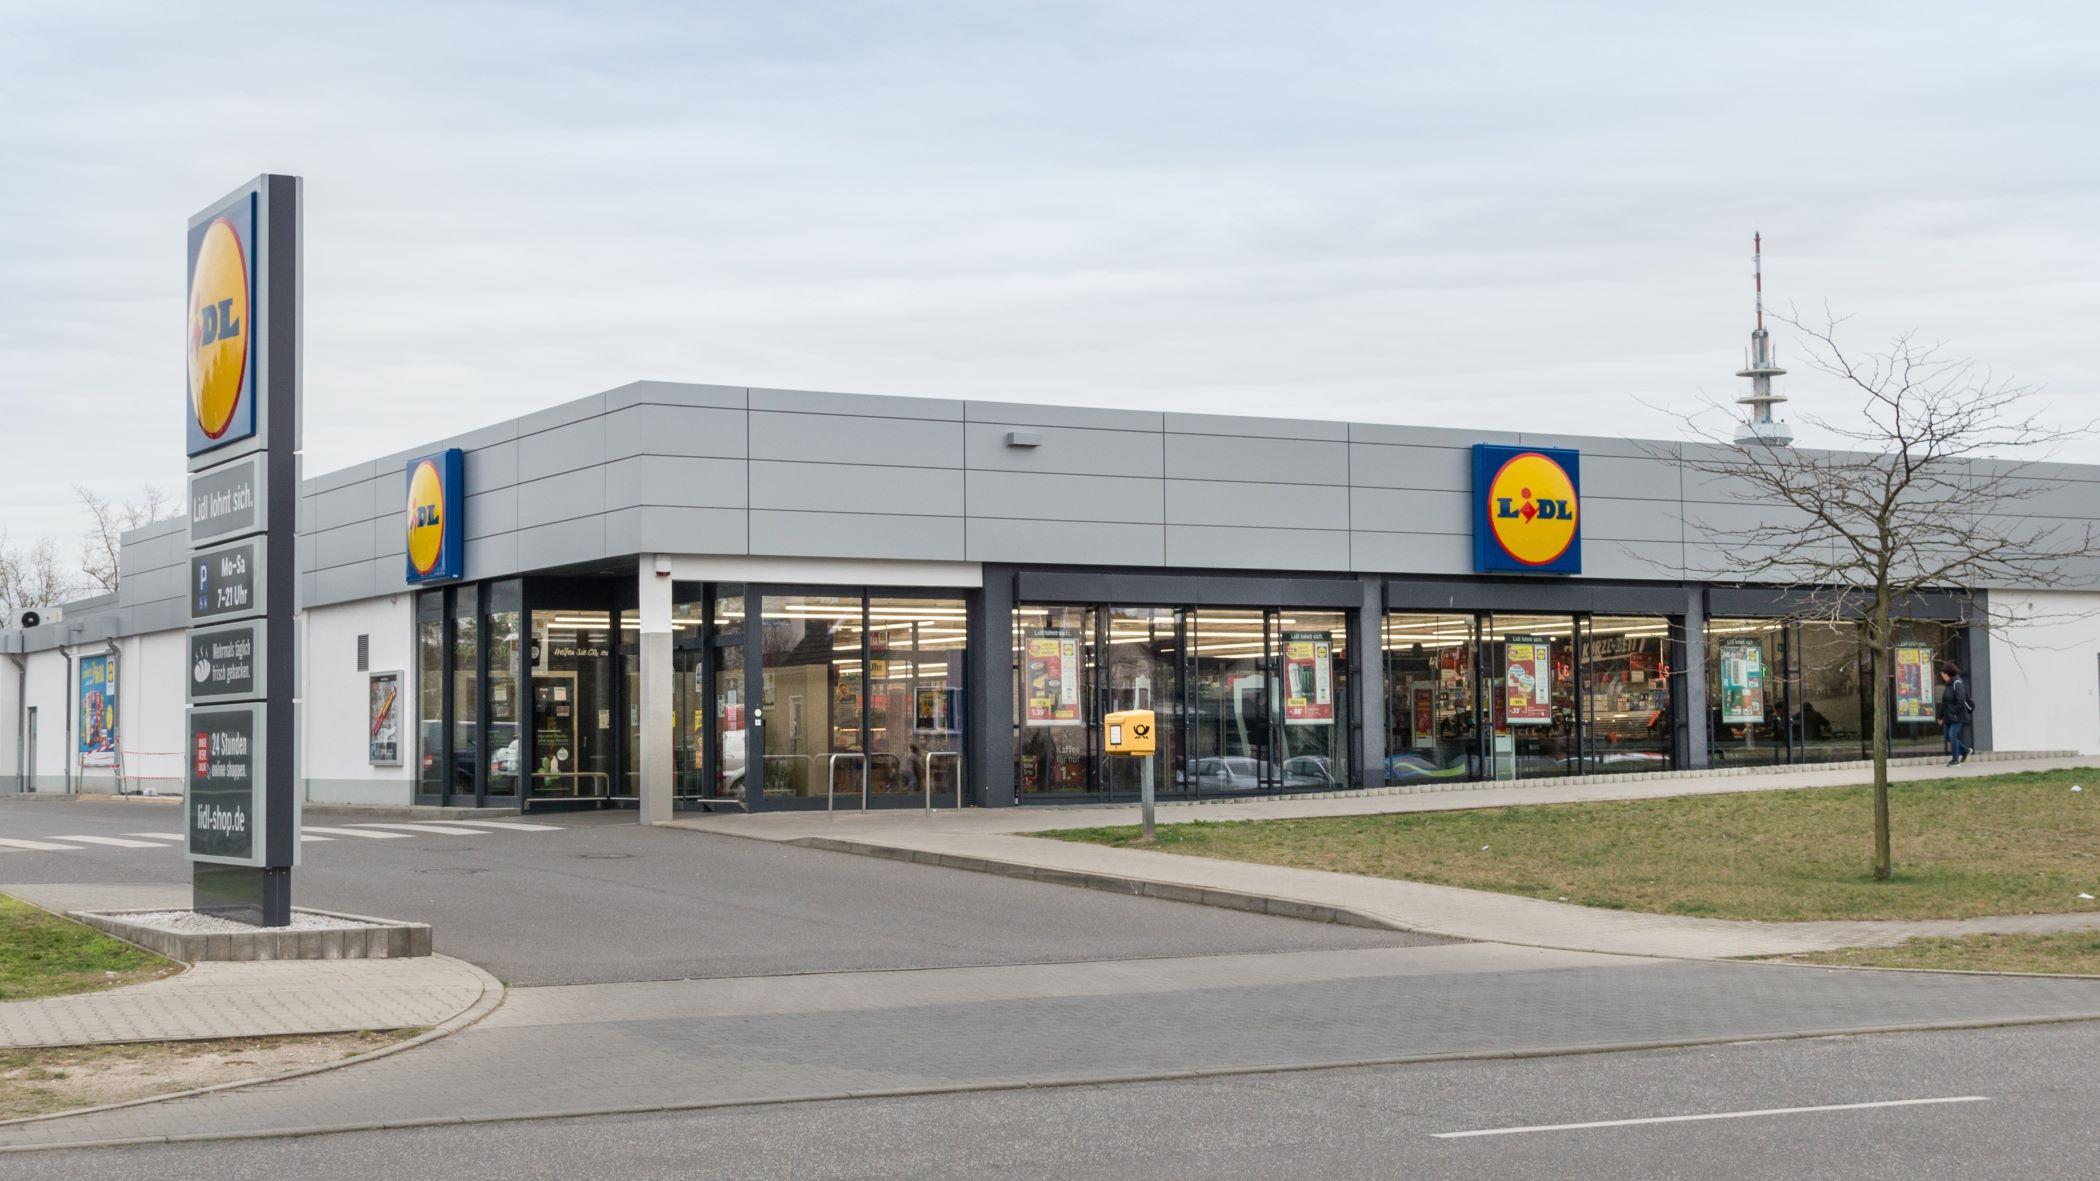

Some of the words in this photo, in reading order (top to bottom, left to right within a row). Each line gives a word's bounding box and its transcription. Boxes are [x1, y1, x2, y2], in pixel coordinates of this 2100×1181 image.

[193, 494, 208, 522] Lidl
[210, 488, 231, 518] lohnt
[233, 481, 253, 512] sich.
[221, 553, 246, 577] Mo-Sa
[200, 565, 208, 590] P
[234, 583, 248, 606] Uhr
[212, 640, 235, 660] Mehrmals
[235, 638, 251, 660] täglich
[554, 647, 575, 657] Helfen
[576, 648, 587, 656] Sie
[212, 663, 226, 681] frisch
[226, 661, 251, 684] gebacken.
[212, 732, 220, 756] 24
[221, 731, 247, 756] Stunden
[1056, 745, 1080, 754] Kaffee
[1057, 755, 1067, 763] für
[197, 804, 245, 837] lidl-shop.de
